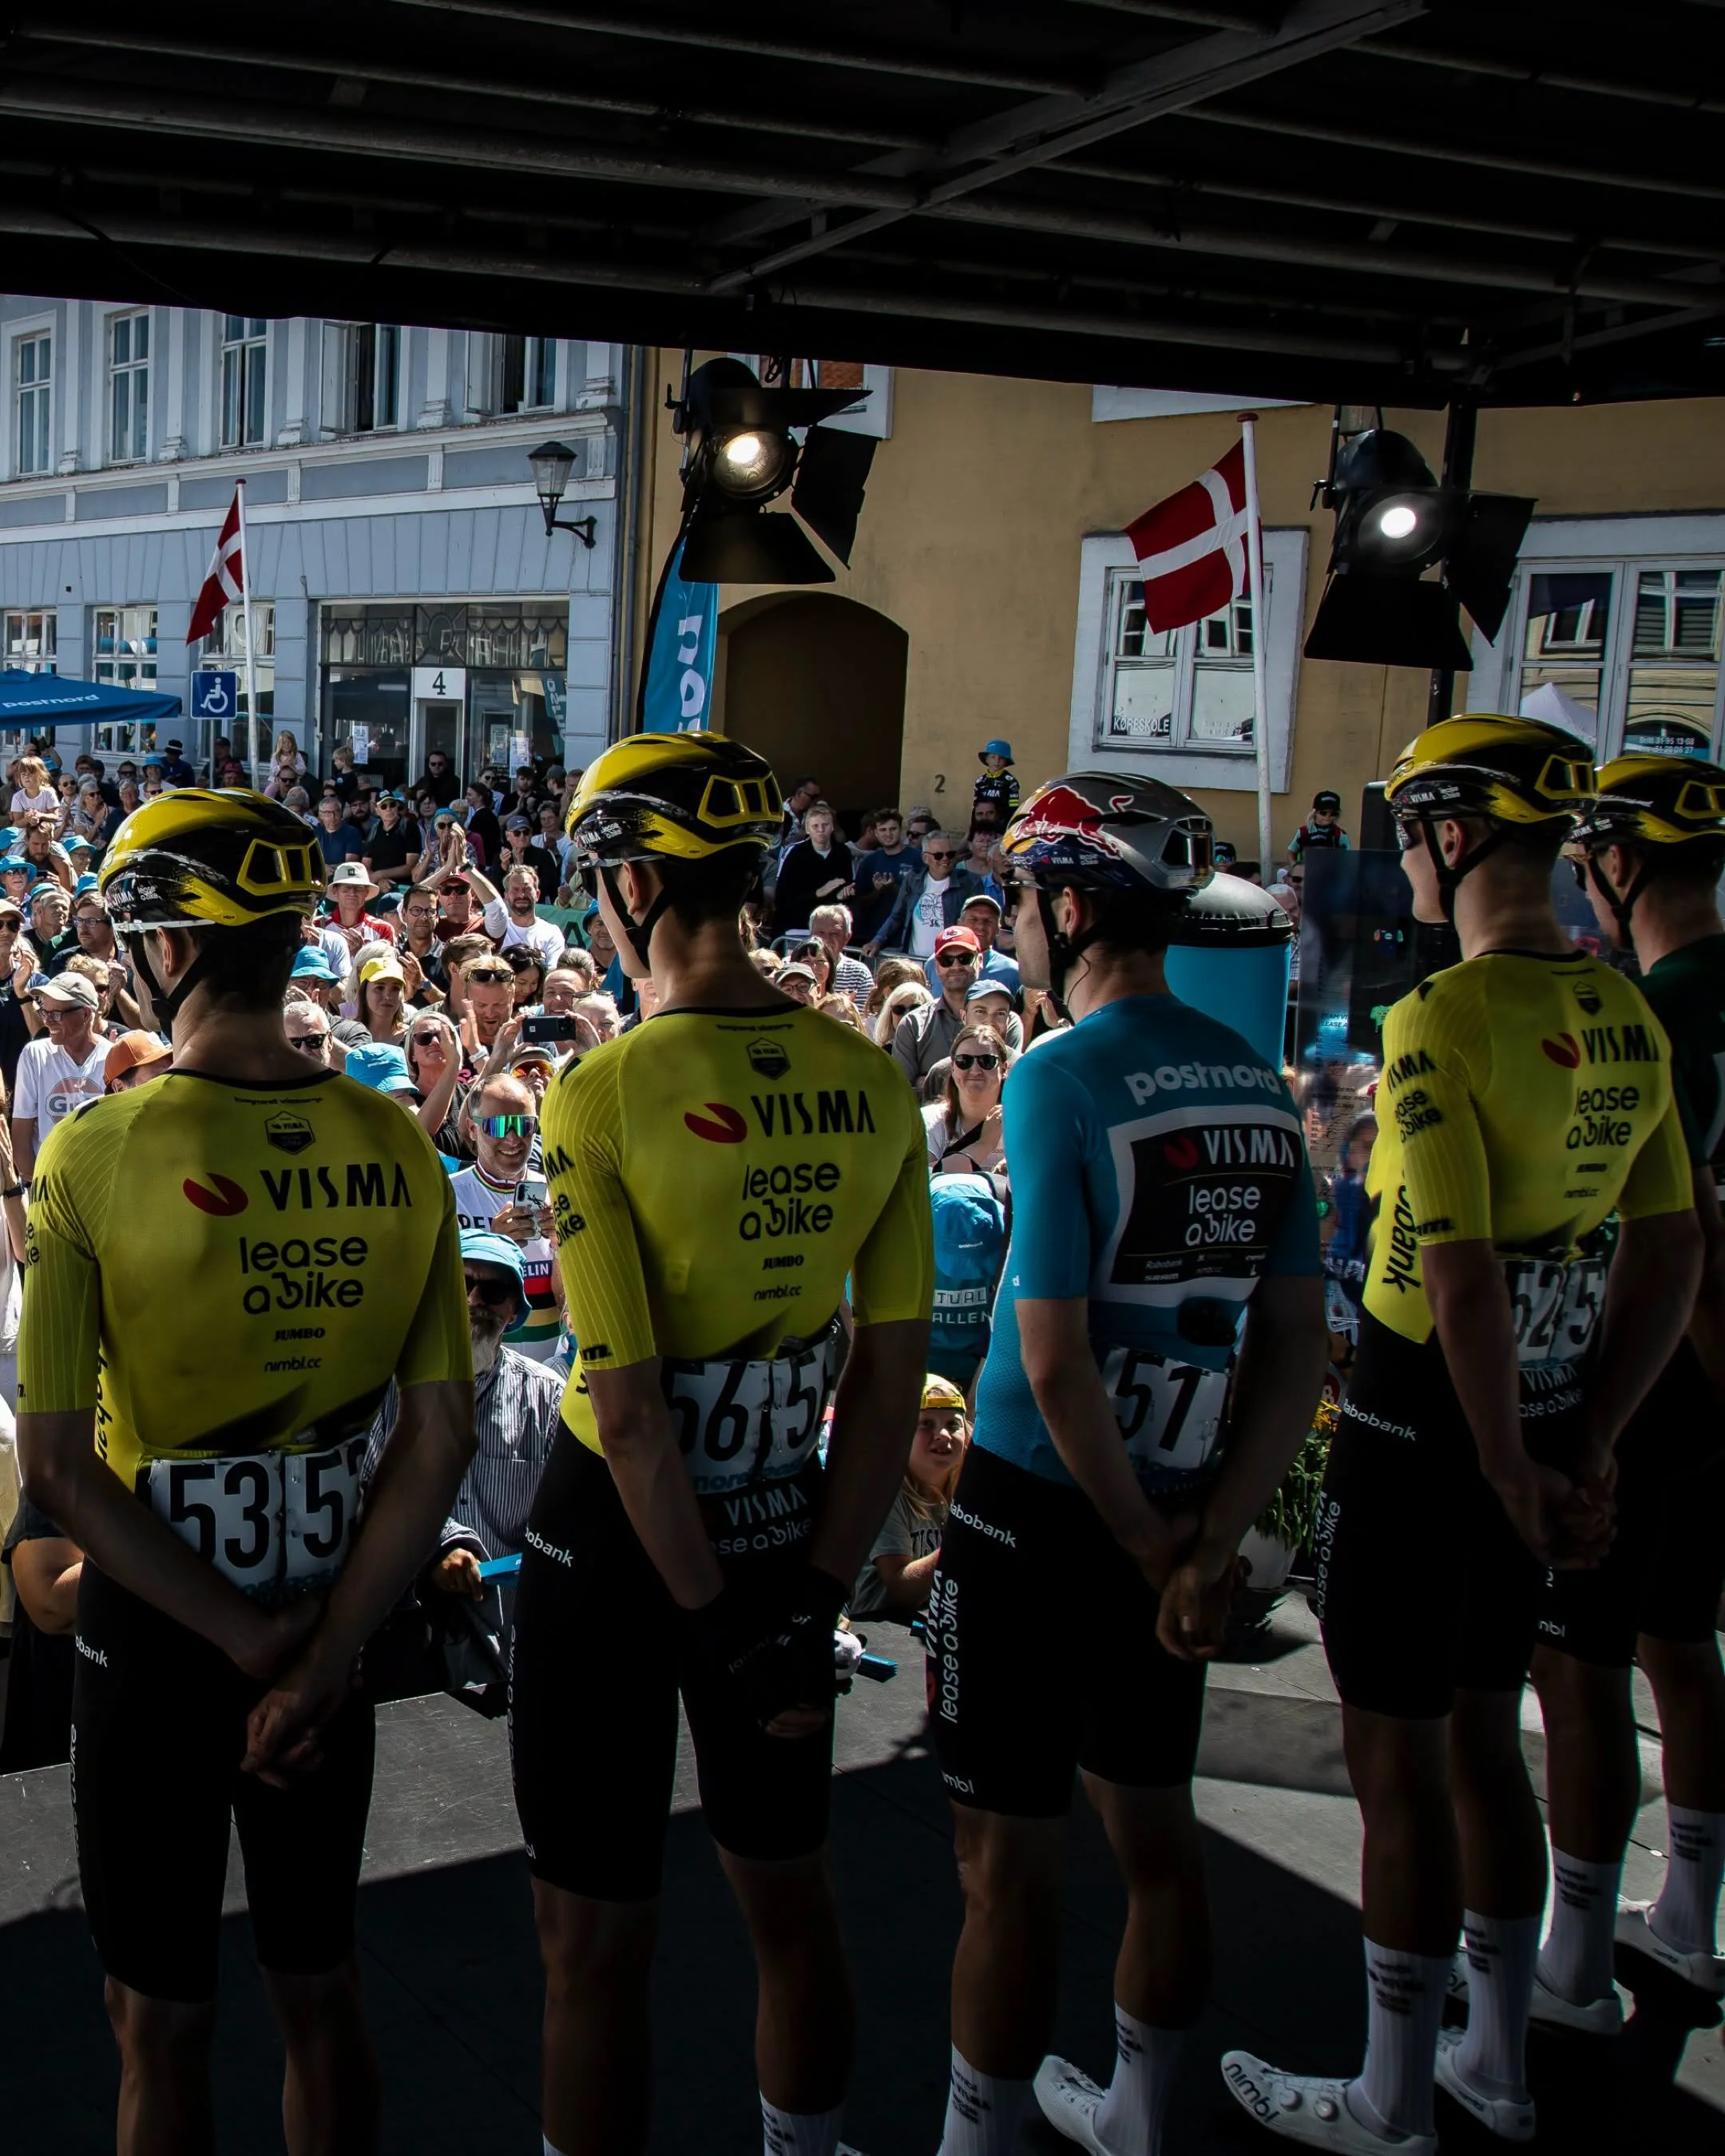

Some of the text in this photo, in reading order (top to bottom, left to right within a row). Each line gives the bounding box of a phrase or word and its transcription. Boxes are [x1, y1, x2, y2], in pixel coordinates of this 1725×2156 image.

[2, 694, 100, 708] postnord
[432, 672, 446, 695] 4
[934, 774, 945, 793] 2
[1124, 1061, 1283, 1106] postnord
[1388, 1051, 1436, 1094] ISMA
[751, 1091, 875, 1137] VISMA
[1396, 1089, 1428, 1121] ase
[1574, 1087, 1639, 1118] lease
[1203, 1129, 1295, 1167] VISMA
[260, 1162, 412, 1211] VISMA
[742, 1163, 841, 1200] lease
[1189, 1184, 1262, 1215] lease
[240, 1237, 368, 1274] lease
[762, 1254, 804, 1270] JUMBO
[1505, 1262, 1563, 1347] 52
[273, 1328, 325, 1342] JUMBO
[264, 1357, 322, 1372] nimbl.cc
[660, 1360, 749, 1461] 56
[1116, 1349, 1202, 1452] 51
[1519, 1403, 1545, 1418] ase
[170, 1460, 269, 1568] 53
[723, 1483, 809, 1528] VISMA
[939, 1654, 959, 1724] lease
[944, 1770, 974, 1794] mbl
[1224, 2063, 1279, 2122] nimbl
